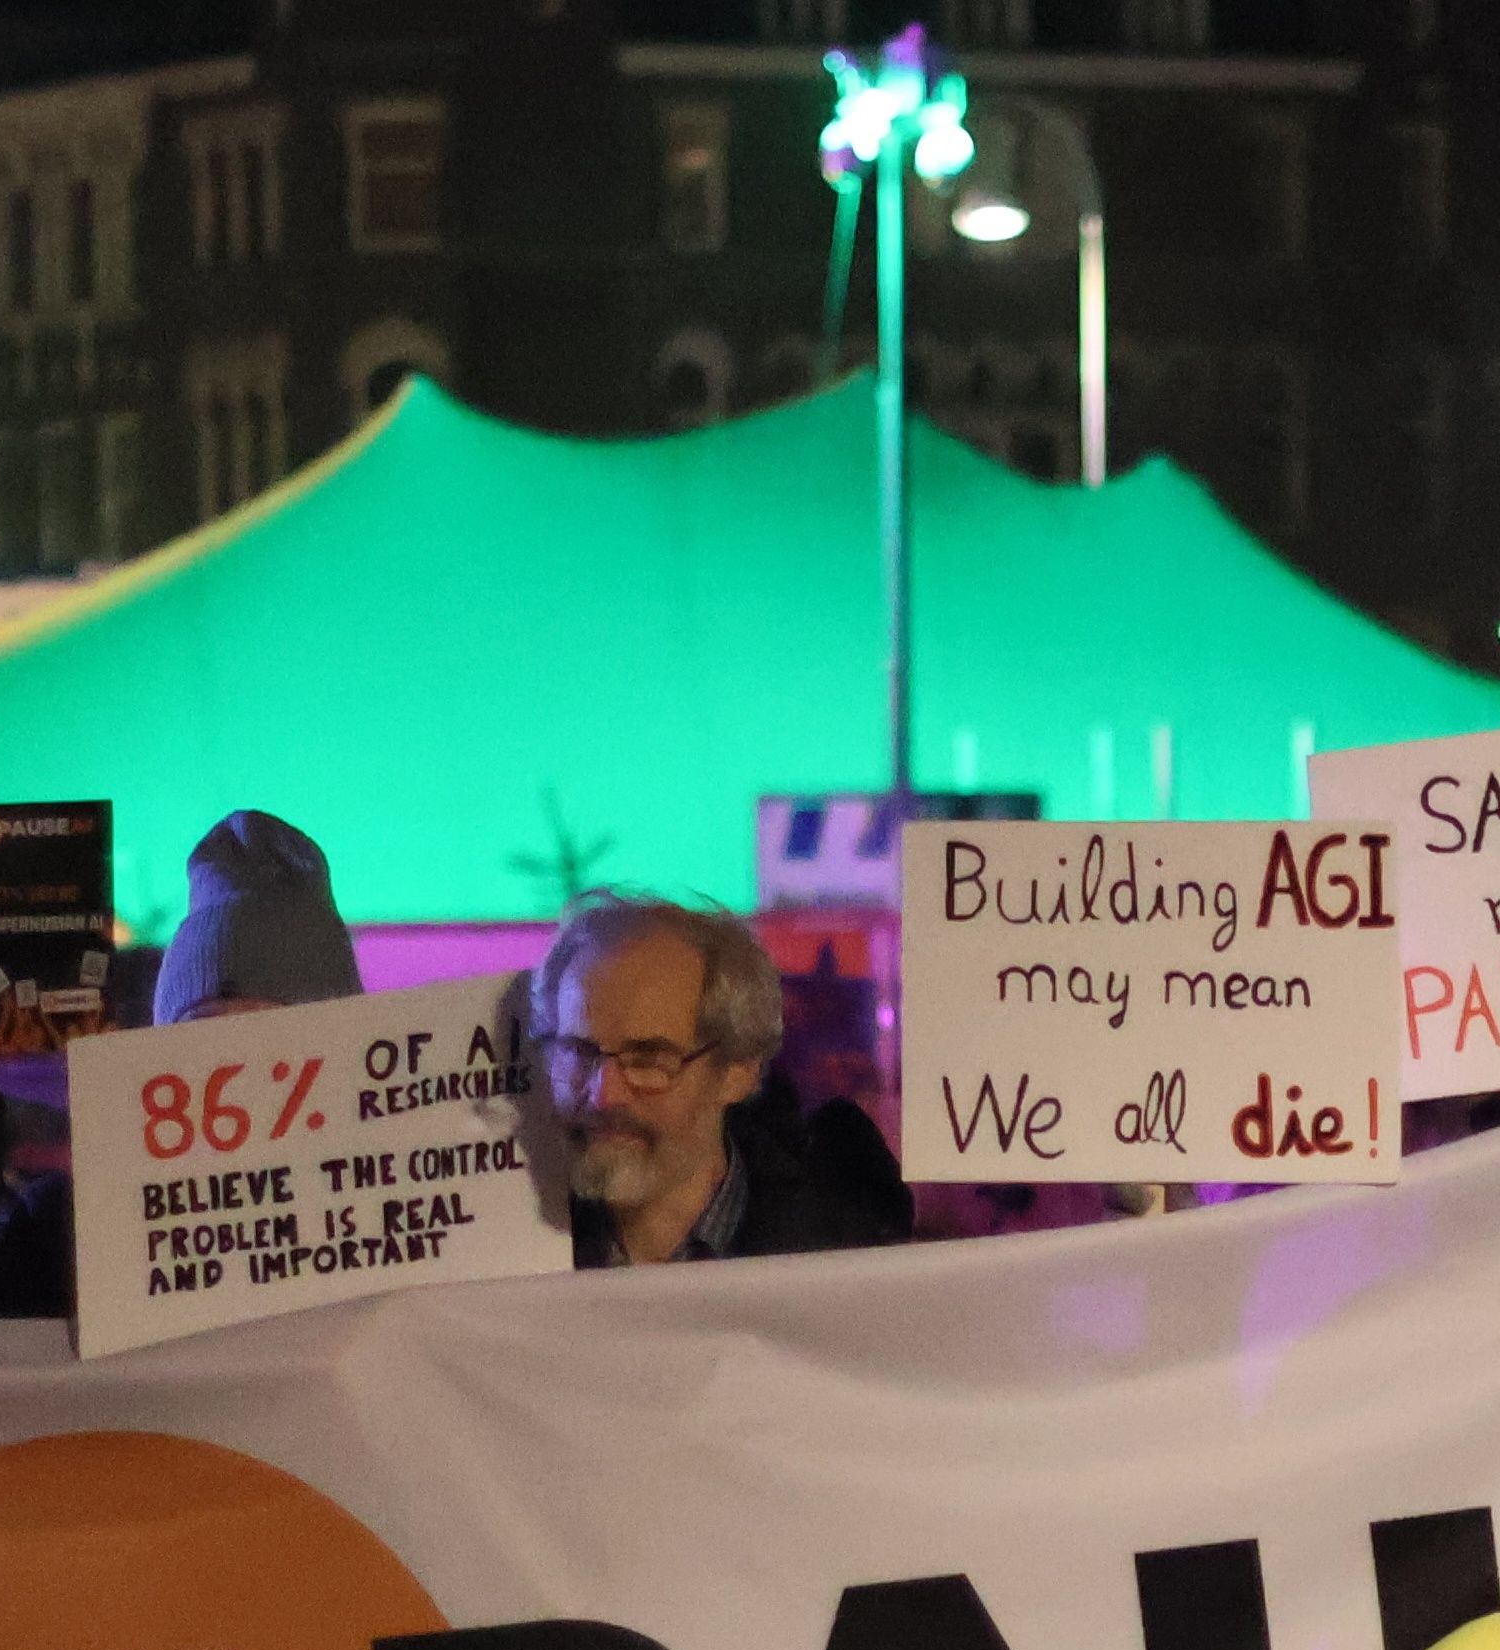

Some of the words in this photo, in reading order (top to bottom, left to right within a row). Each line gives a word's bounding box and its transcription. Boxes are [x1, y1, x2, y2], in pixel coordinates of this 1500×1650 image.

[942, 833, 1239, 952] Building
[1256, 829, 1395, 929] AGI
[997, 964, 1132, 1029] may
[1163, 969, 1312, 1010] mean
[140, 1057, 326, 1160] 86%
[365, 1032, 433, 1081] OF
[466, 1016, 521, 1066] AI
[358, 1062, 532, 1121] RESEARCHERS
[941, 1071, 1066, 1159] We
[1114, 1068, 1187, 1155] all
[1232, 1071, 1379, 1159] die!
[142, 1166, 296, 1222] BELIEVE
[320, 1153, 397, 1192] THE
[408, 1135, 525, 1183] CONTROL
[147, 1212, 299, 1262] PROBLEM
[324, 1205, 357, 1241] IS
[382, 1192, 476, 1236] REAL
[148, 1260, 224, 1298] AND
[249, 1230, 450, 1285] IMPORTANT
